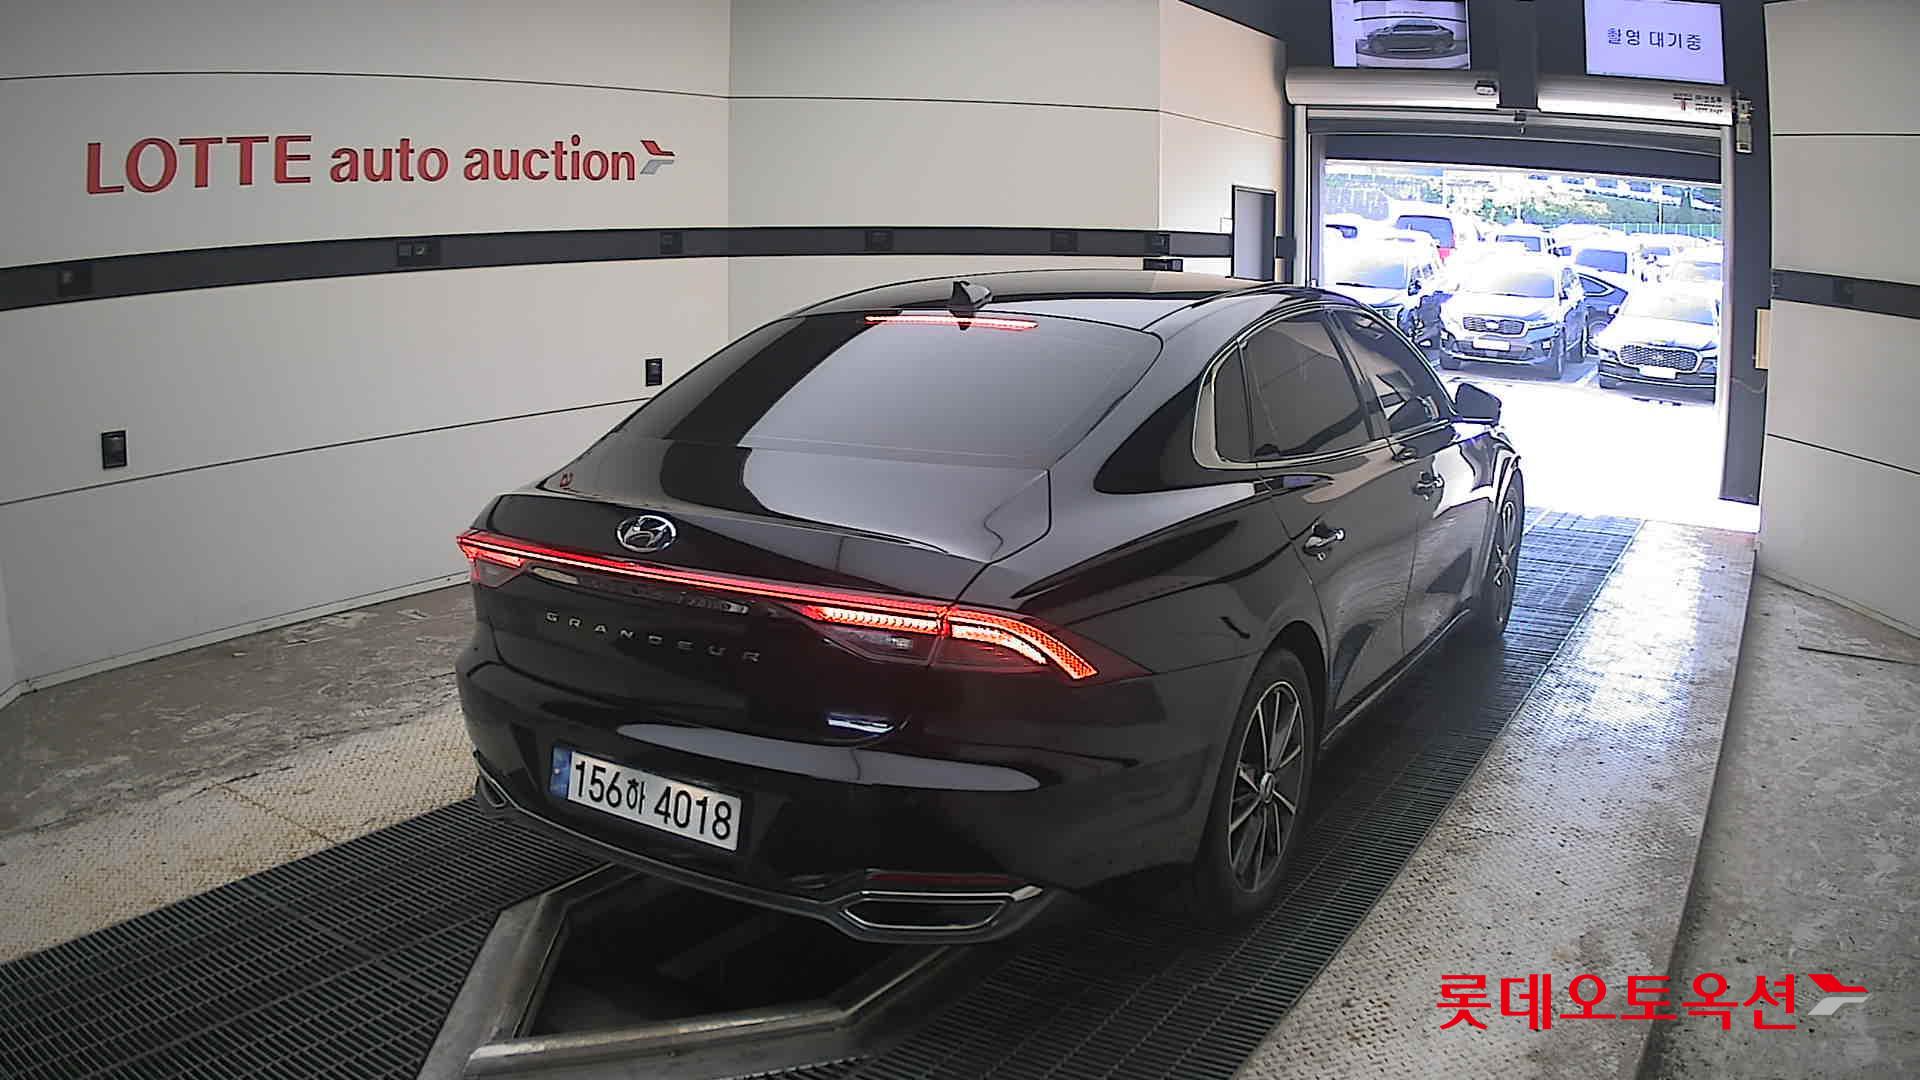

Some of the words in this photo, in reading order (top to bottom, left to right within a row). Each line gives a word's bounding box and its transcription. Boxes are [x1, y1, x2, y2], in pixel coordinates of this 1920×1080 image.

[1649, 31, 1702, 51] 대기중
[86, 135, 312, 195] LOTTE
[329, 138, 450, 183] auto
[463, 135, 636, 182] auction
[546, 611, 761, 662] GRANDEUR
[575, 760, 646, 815] 156하
[654, 785, 733, 840] 4018
